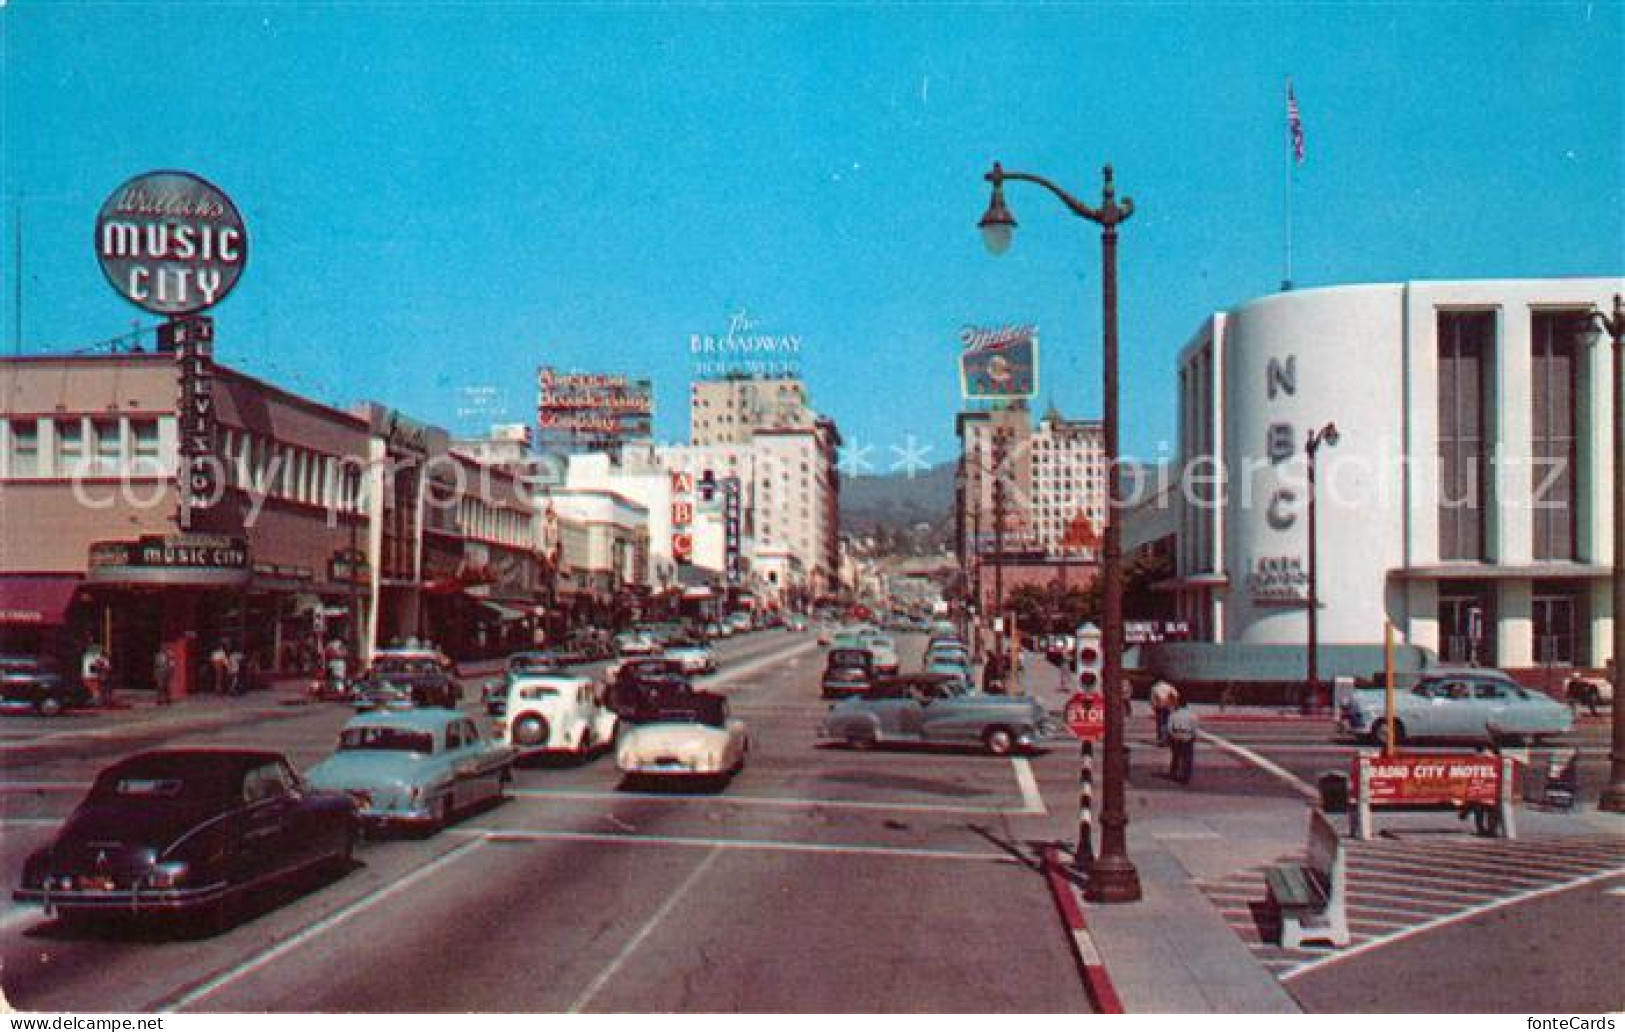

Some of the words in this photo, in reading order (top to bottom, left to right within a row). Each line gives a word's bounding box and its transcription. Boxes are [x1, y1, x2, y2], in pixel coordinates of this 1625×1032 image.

[104, 221, 240, 262] MUSIC
[129, 265, 220, 304] CITY
[691, 333, 801, 354] BROADWAY
[1266, 354, 1297, 532] NBC
[673, 472, 691, 553] ABC
[212, 549, 244, 565] CITY
[1413, 765, 1445, 778] CITY
[1448, 766, 1496, 778] MOTEL
